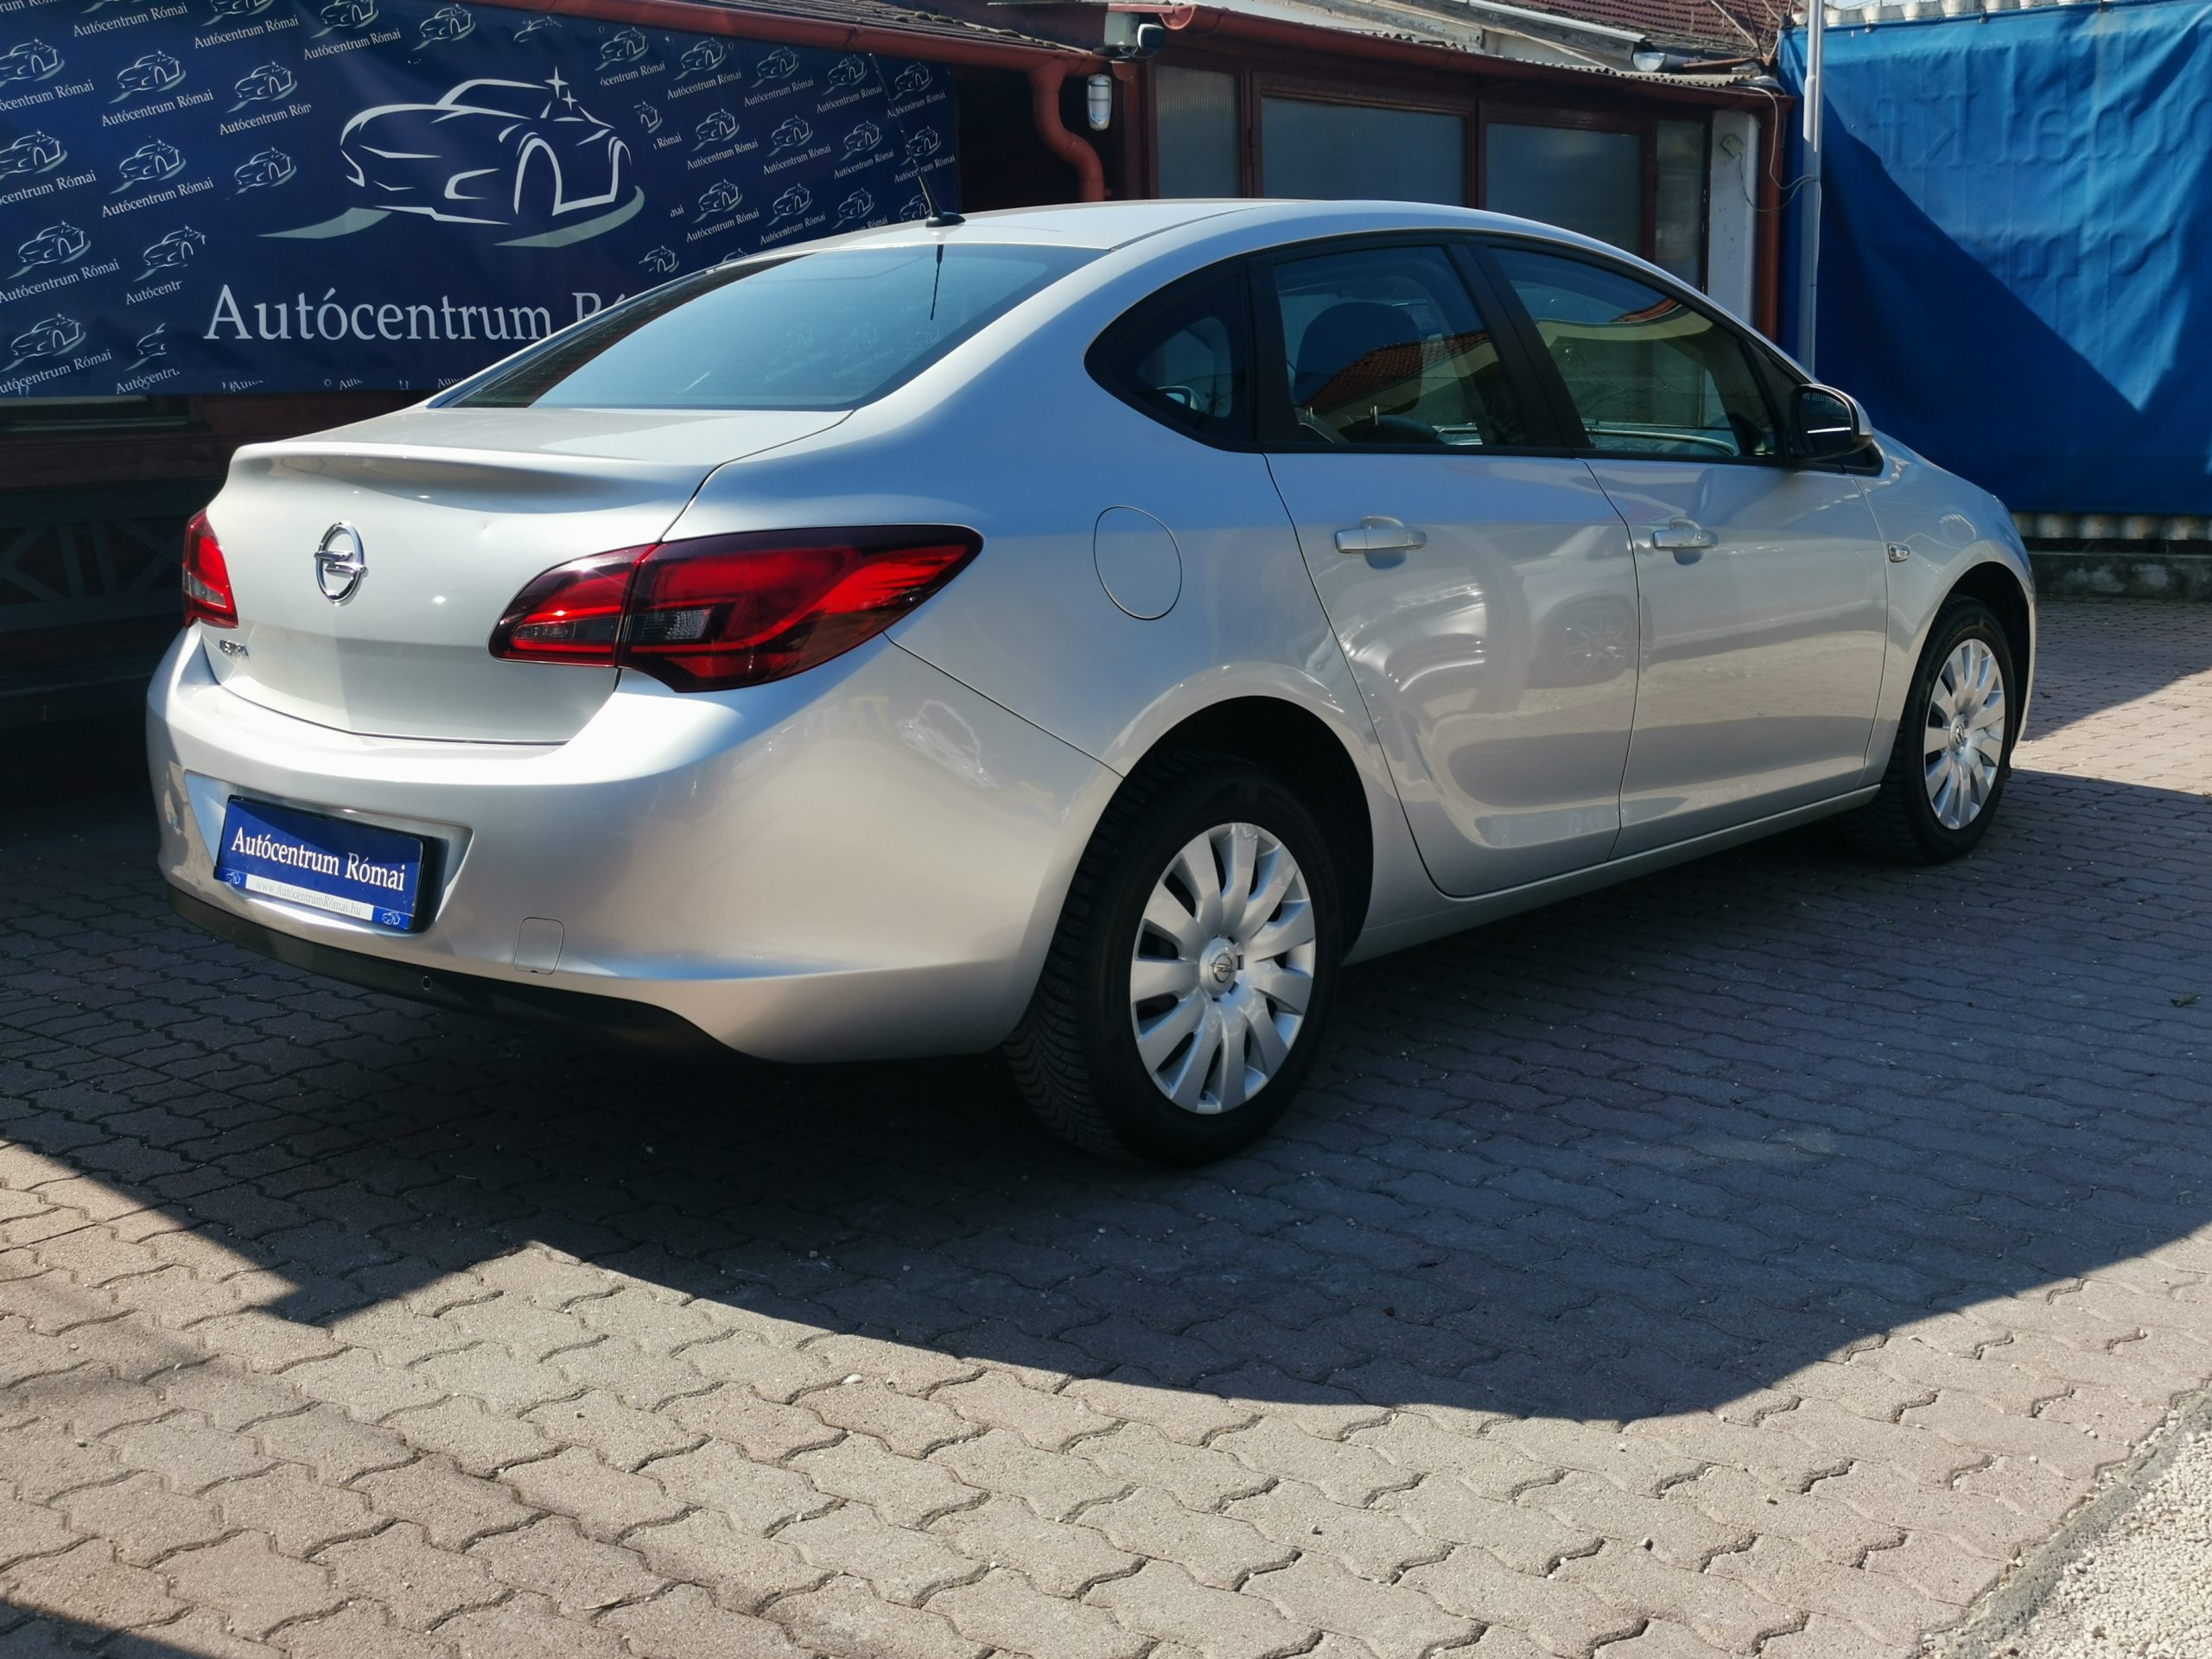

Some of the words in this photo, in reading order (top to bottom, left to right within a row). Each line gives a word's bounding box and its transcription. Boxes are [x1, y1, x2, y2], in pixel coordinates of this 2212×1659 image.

[74, 12, 149, 37] Autócentrum
[150, 3, 188, 20] Római
[194, 25, 264, 48] Autócentrum
[265, 15, 299, 32] Római
[304, 36, 370, 60] Autócentrum
[370, 28, 401, 44] Római
[601, 70, 639, 86] ócentrum
[639, 60, 665, 77] Római
[667, 78, 716, 100] Autócentrum
[717, 69, 742, 85] Római
[0, 92, 54, 111] ócentrum
[55, 79, 95, 99] Római
[102, 102, 176, 127] Autócentrum
[177, 89, 214, 109] Római
[744, 86, 791, 107] Autócentrum
[791, 78, 815, 92] Római
[817, 92, 861, 113] Autócentrum
[861, 85, 882, 99] Római
[925, 90, 946, 105] Római
[220, 110, 288, 136] Autócentrum
[289, 103, 312, 118] Róm
[657, 132, 682, 149] Római
[687, 147, 734, 170] Autócentrum
[734, 138, 759, 154] Római
[763, 153, 807, 175] Autócentrum
[808, 145, 831, 160] Római
[834, 157, 874, 180] Autócentrum
[874, 149, 894, 164] Római
[894, 162, 934, 184] Autócerum
[934, 153, 956, 168] Római
[0, 183, 54, 206] centrum
[55, 169, 98, 190] Római
[102, 189, 177, 217] Autócentrum
[177, 176, 214, 197] Római
[671, 203, 684, 218] mai
[686, 217, 735, 243] Autócentrum
[735, 207, 760, 225] Római
[760, 221, 804, 245] Autócentrum
[804, 213, 826, 228] Római
[0, 271, 79, 302] Autócentrum
[81, 258, 120, 280] Római
[126, 280, 183, 305] Autócentr
[203, 283, 552, 340] Autócentrum
[0, 364, 72, 394] utócentrum
[73, 348, 112, 371] Római
[116, 367, 181, 395] Autócentru
[232, 826, 340, 876] Autócentrum
[345, 852, 406, 891] Római
